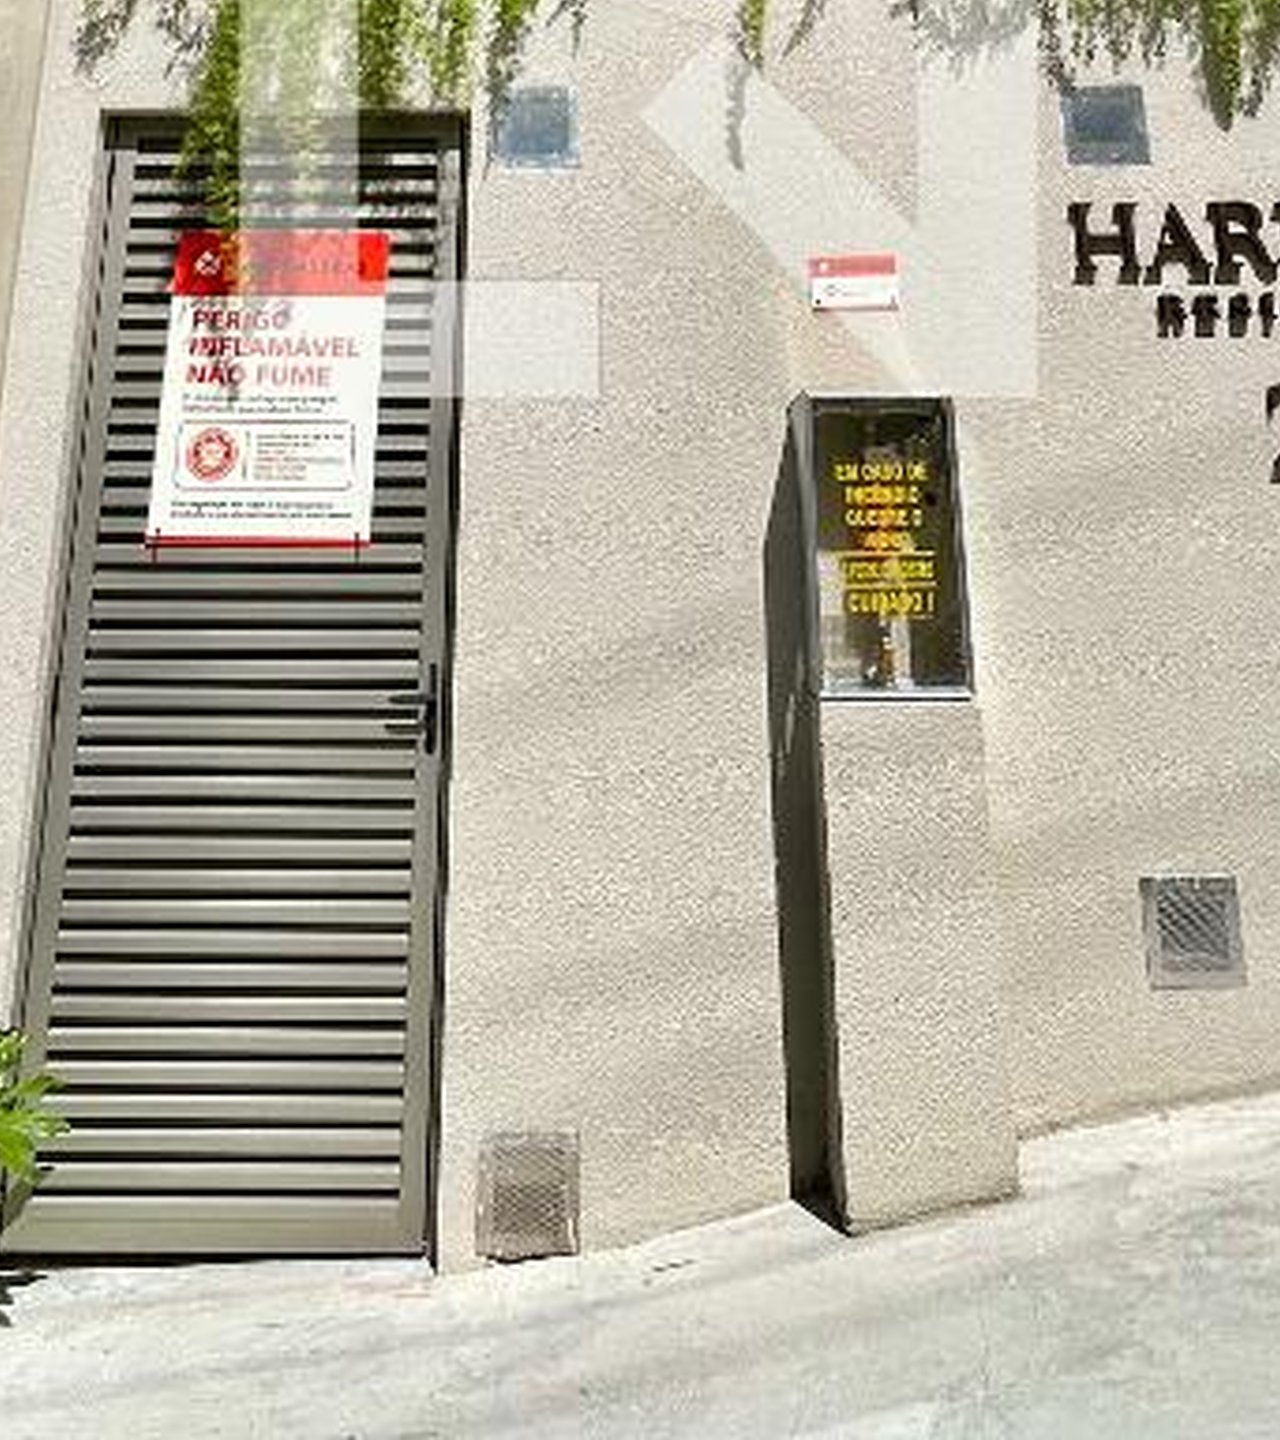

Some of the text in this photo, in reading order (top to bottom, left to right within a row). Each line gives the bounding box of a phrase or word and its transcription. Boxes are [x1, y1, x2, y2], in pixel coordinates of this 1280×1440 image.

[192, 308, 290, 330] PERIGO
[189, 334, 361, 358] INFLAMÁVEL
[186, 360, 334, 388] NÃO FUME
